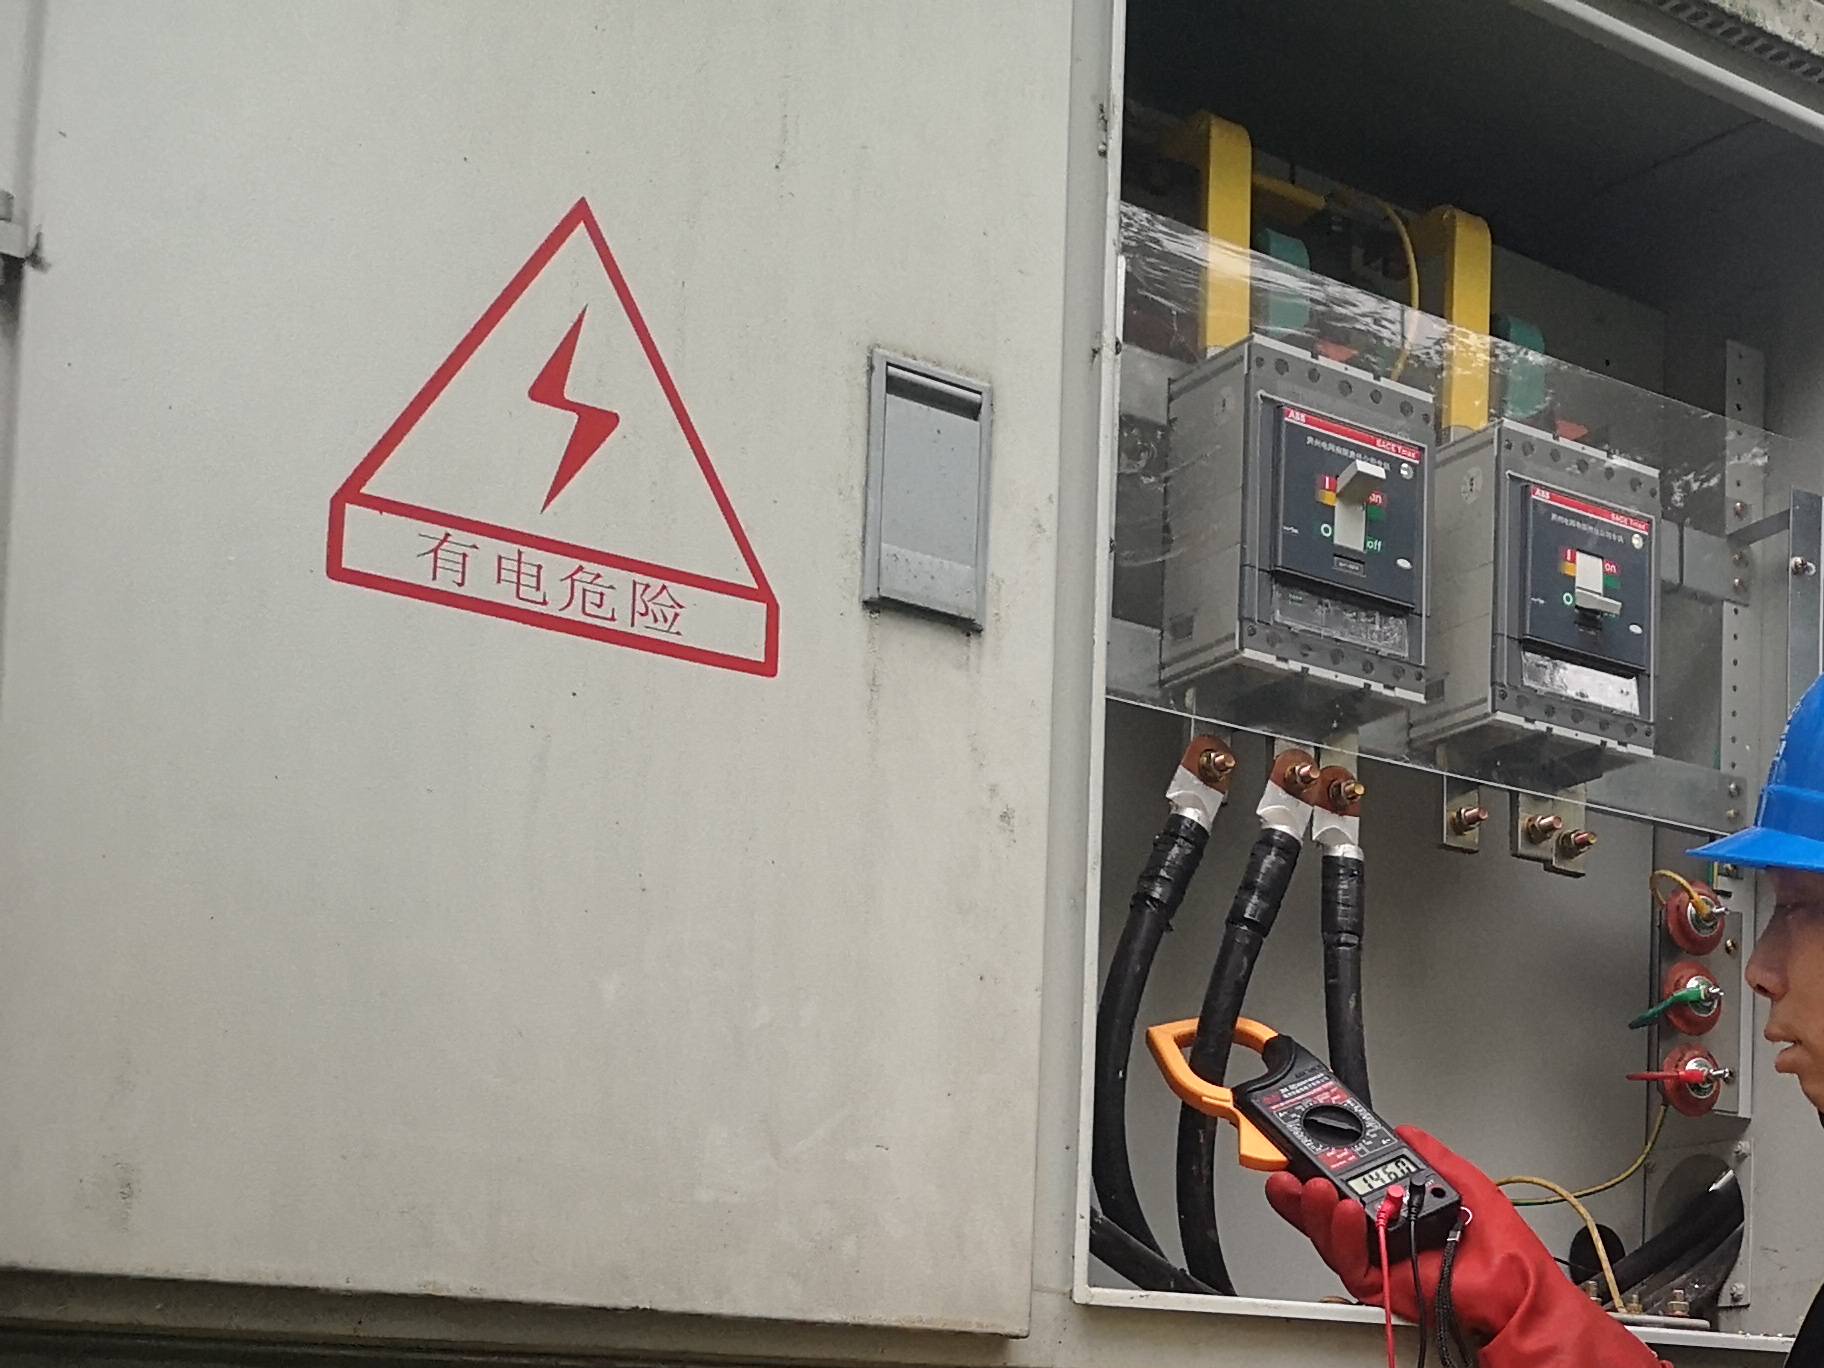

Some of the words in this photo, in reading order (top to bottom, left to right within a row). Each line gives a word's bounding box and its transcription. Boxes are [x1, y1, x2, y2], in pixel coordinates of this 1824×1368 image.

[1288, 409, 1306, 423] ABB
[1366, 539, 1382, 552] off
[417, 532, 685, 636] 有电危险
